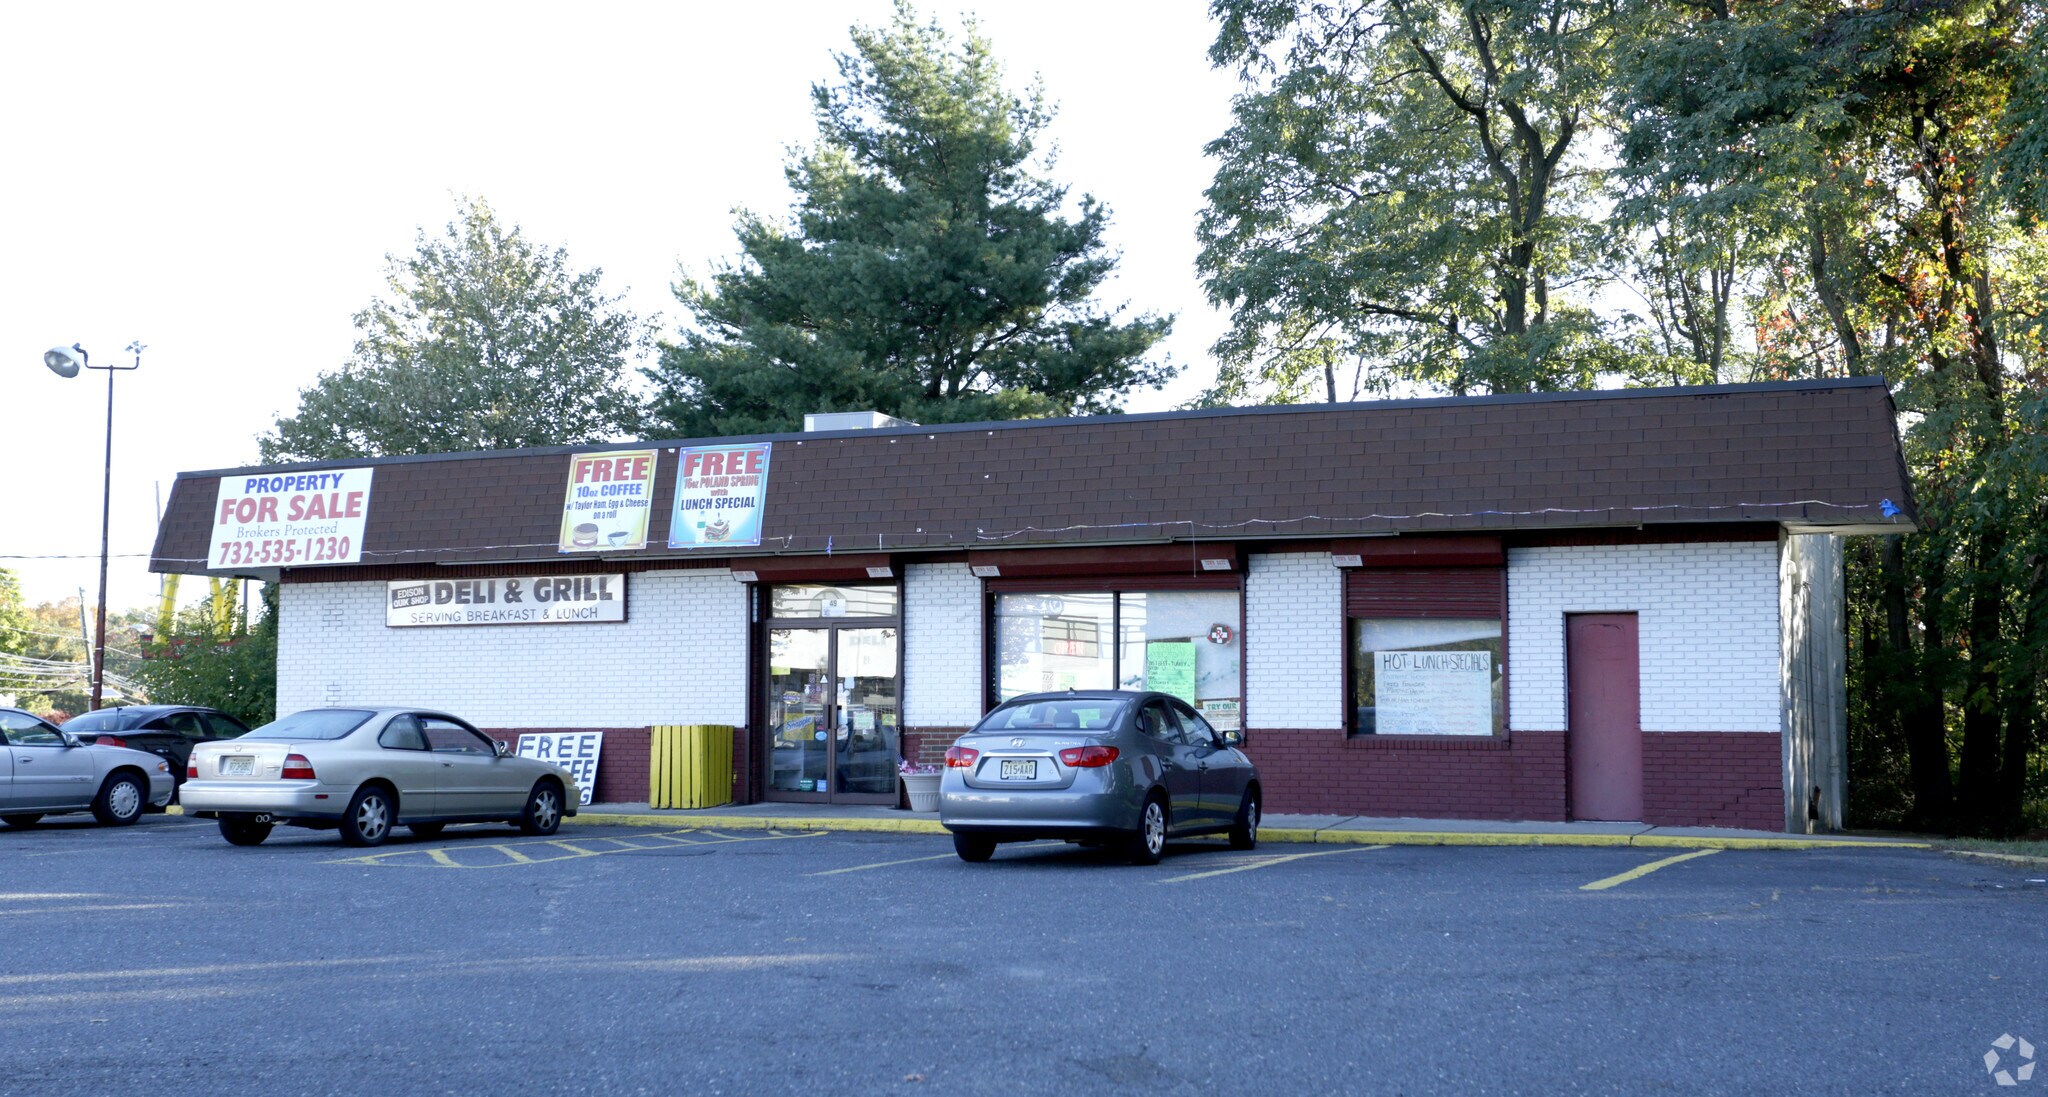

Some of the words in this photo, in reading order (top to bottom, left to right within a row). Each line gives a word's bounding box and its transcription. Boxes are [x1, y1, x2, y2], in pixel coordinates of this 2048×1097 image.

[574, 457, 650, 483] FREE
[683, 451, 764, 477] FREE
[245, 473, 344, 494] PROPERTY
[700, 476, 729, 488] POLAND
[731, 475, 759, 487] SPRING
[577, 486, 599, 498] 10oz
[601, 483, 642, 496] COFFEE
[711, 488, 728, 496] with
[220, 496, 278, 525] FOR
[288, 491, 364, 521] SALE
[575, 501, 592, 510] Taylor
[609, 499, 619, 509] Egg
[625, 498, 648, 507] Cheese
[681, 498, 713, 510] LUNCH
[715, 496, 755, 509] SPECIAL
[593, 511, 601, 519] on
[606, 510, 617, 518] roll
[236, 525, 280, 539] Brokers
[284, 521, 338, 536] Protected
[219, 536, 350, 565] 732-535-1230
[397, 587, 424, 599] EDISON
[435, 579, 496, 605] DELI
[504, 578, 523, 604] &
[533, 576, 613, 603] GRILL
[393, 599, 410, 608] QUIK
[410, 595, 429, 605] SHOP
[410, 611, 461, 623] SERVING
[467, 609, 536, 622] BREAKFAST
[542, 609, 550, 619] &
[557, 607, 598, 619] LUNCH
[1055, 641, 1084, 655] OPEN
[1383, 653, 1408, 670] HOT
[1413, 653, 1449, 670] LUNCH
[1450, 653, 1489, 671] SPECIALS
[785, 716, 812, 731] Snapple
[518, 735, 596, 758] FREE
